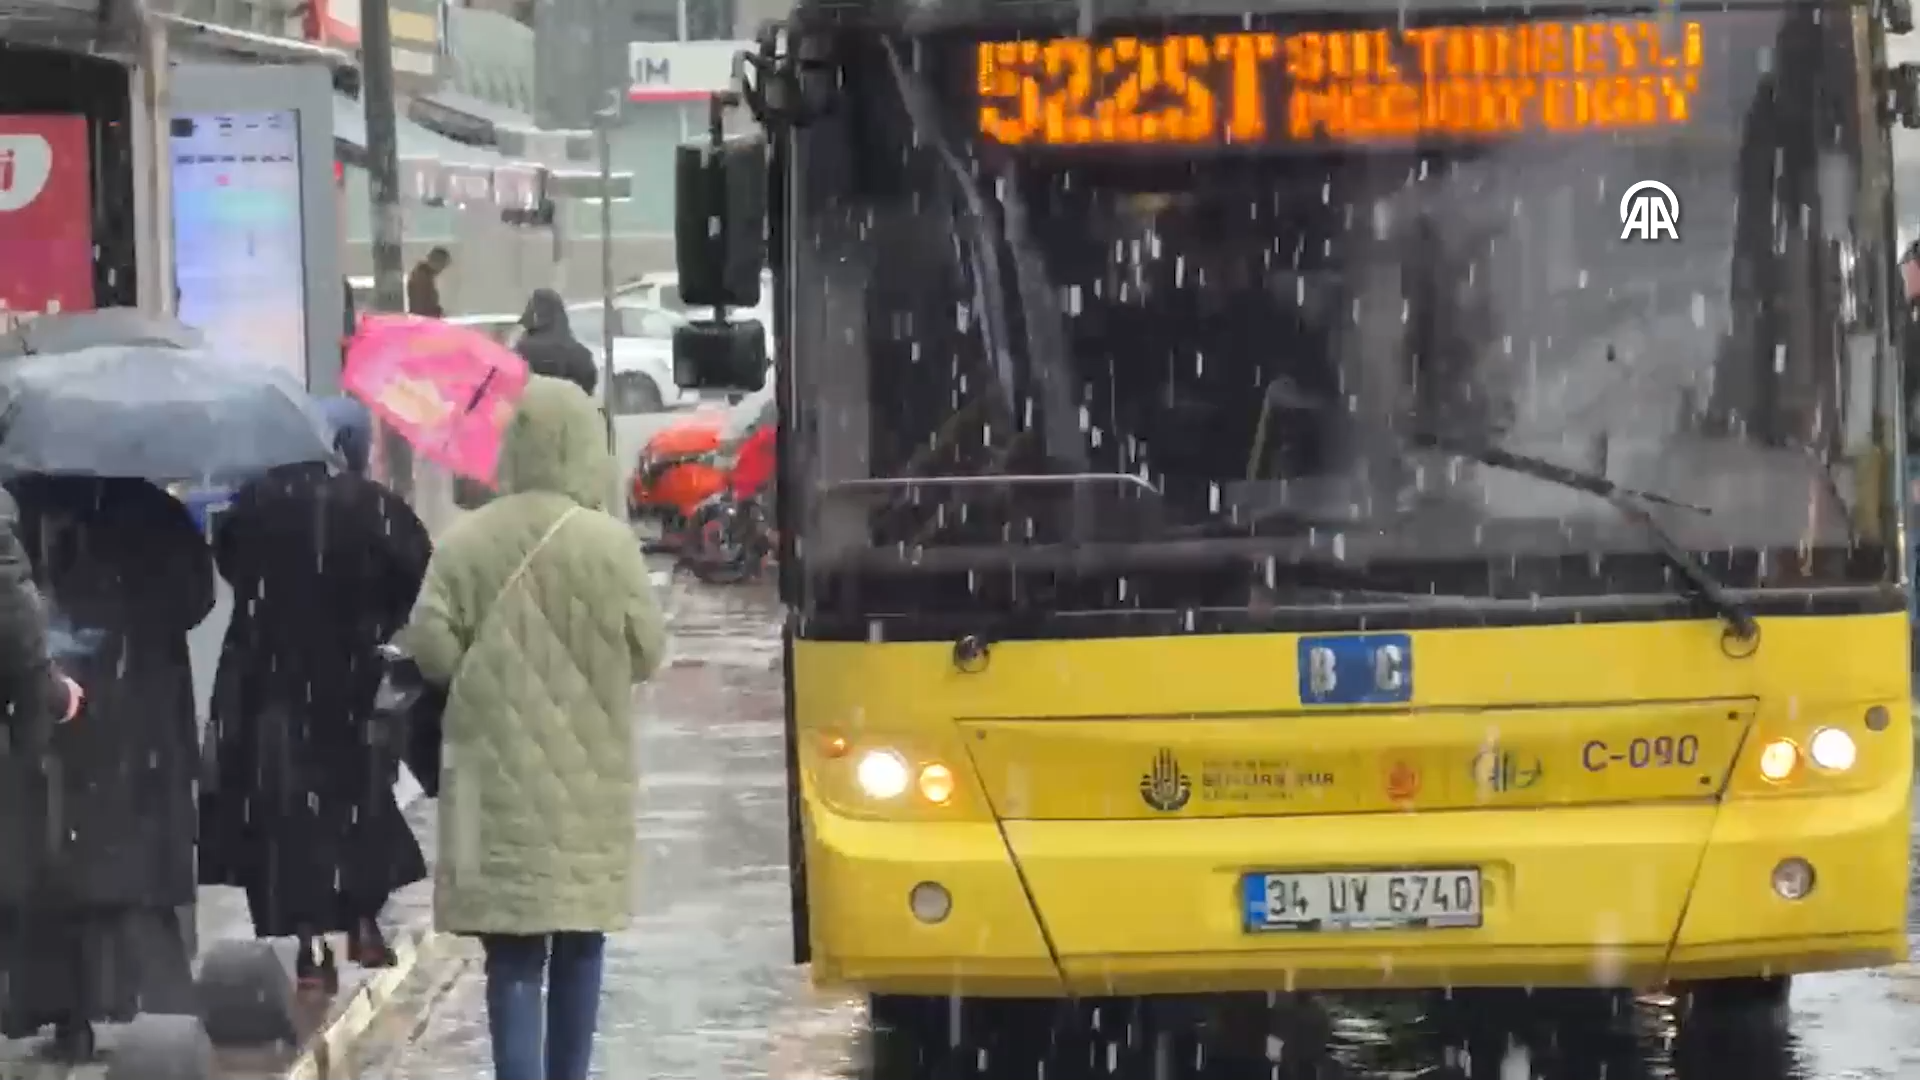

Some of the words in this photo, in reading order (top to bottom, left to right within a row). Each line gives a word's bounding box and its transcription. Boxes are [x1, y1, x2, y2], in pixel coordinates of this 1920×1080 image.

[978, 33, 1277, 145] 522ST
[1310, 647, 1337, 697] B
[1376, 644, 1403, 690] C
[1582, 734, 1699, 772] C-090
[1268, 879, 1309, 916] 34
[1389, 875, 1474, 913] 6740
